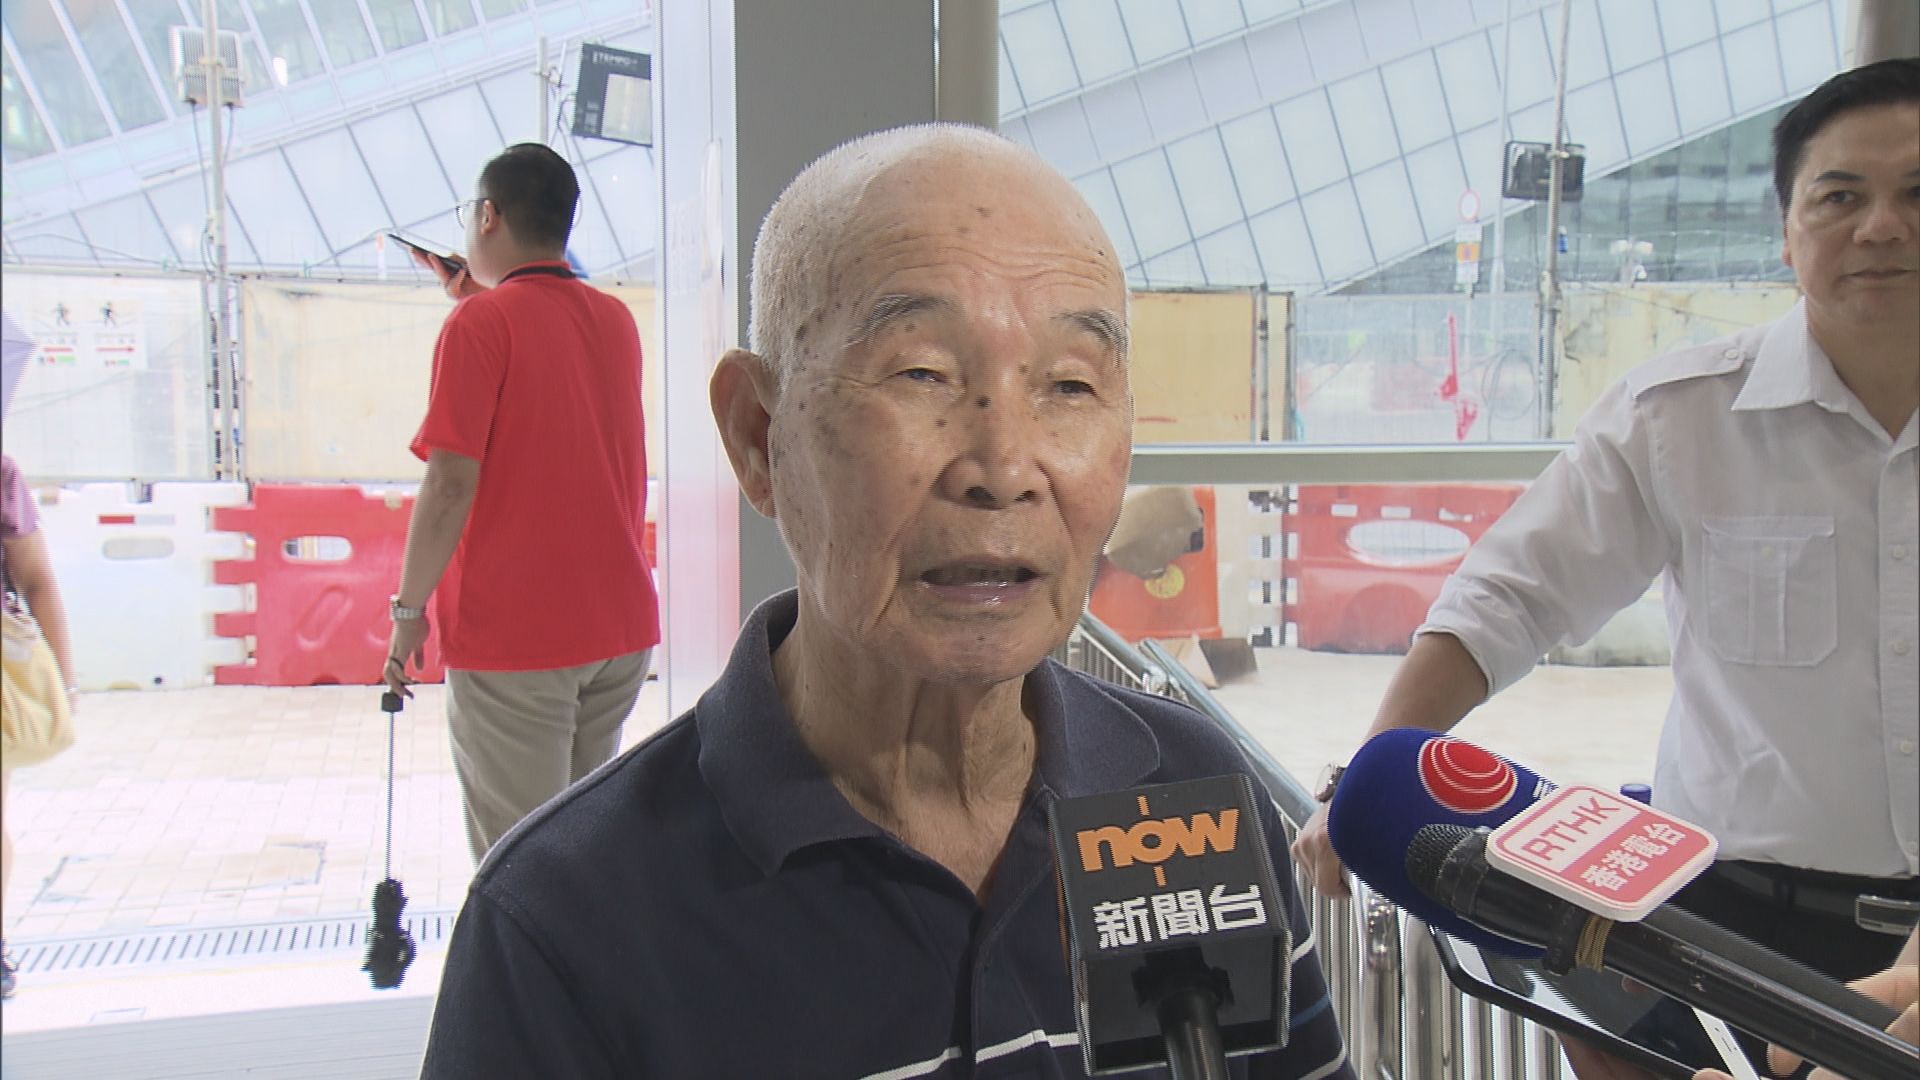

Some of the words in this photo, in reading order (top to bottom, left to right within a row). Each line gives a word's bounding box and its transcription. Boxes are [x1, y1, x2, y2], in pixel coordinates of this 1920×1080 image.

[1077, 808, 1239, 872] now
[1520, 797, 1621, 861] RTHK
[1581, 822, 1686, 891] 香港電台
[1092, 884, 1266, 949] 新聞台
